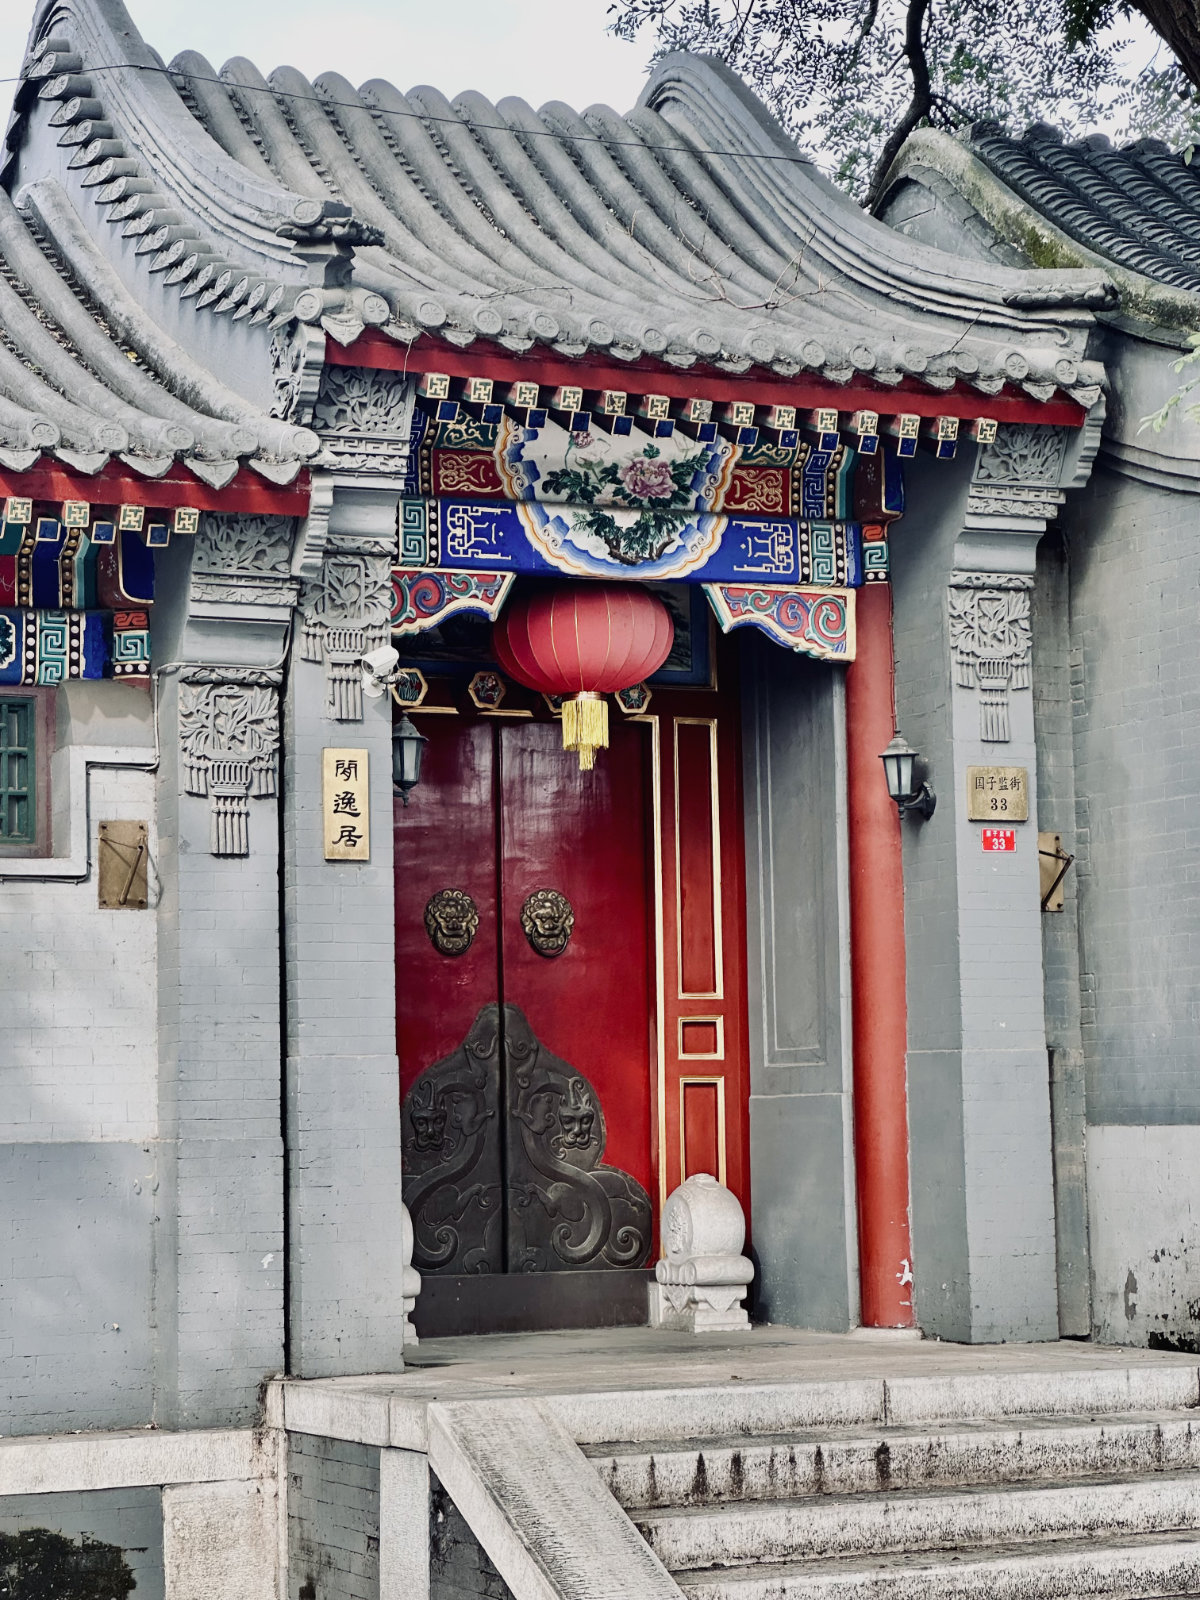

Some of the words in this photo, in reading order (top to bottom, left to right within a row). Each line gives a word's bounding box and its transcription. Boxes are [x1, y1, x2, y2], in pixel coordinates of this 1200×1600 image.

[975, 776, 1021, 791] 国子监街
[990, 797, 1008, 811] 33
[992, 838, 1006, 850] 33
